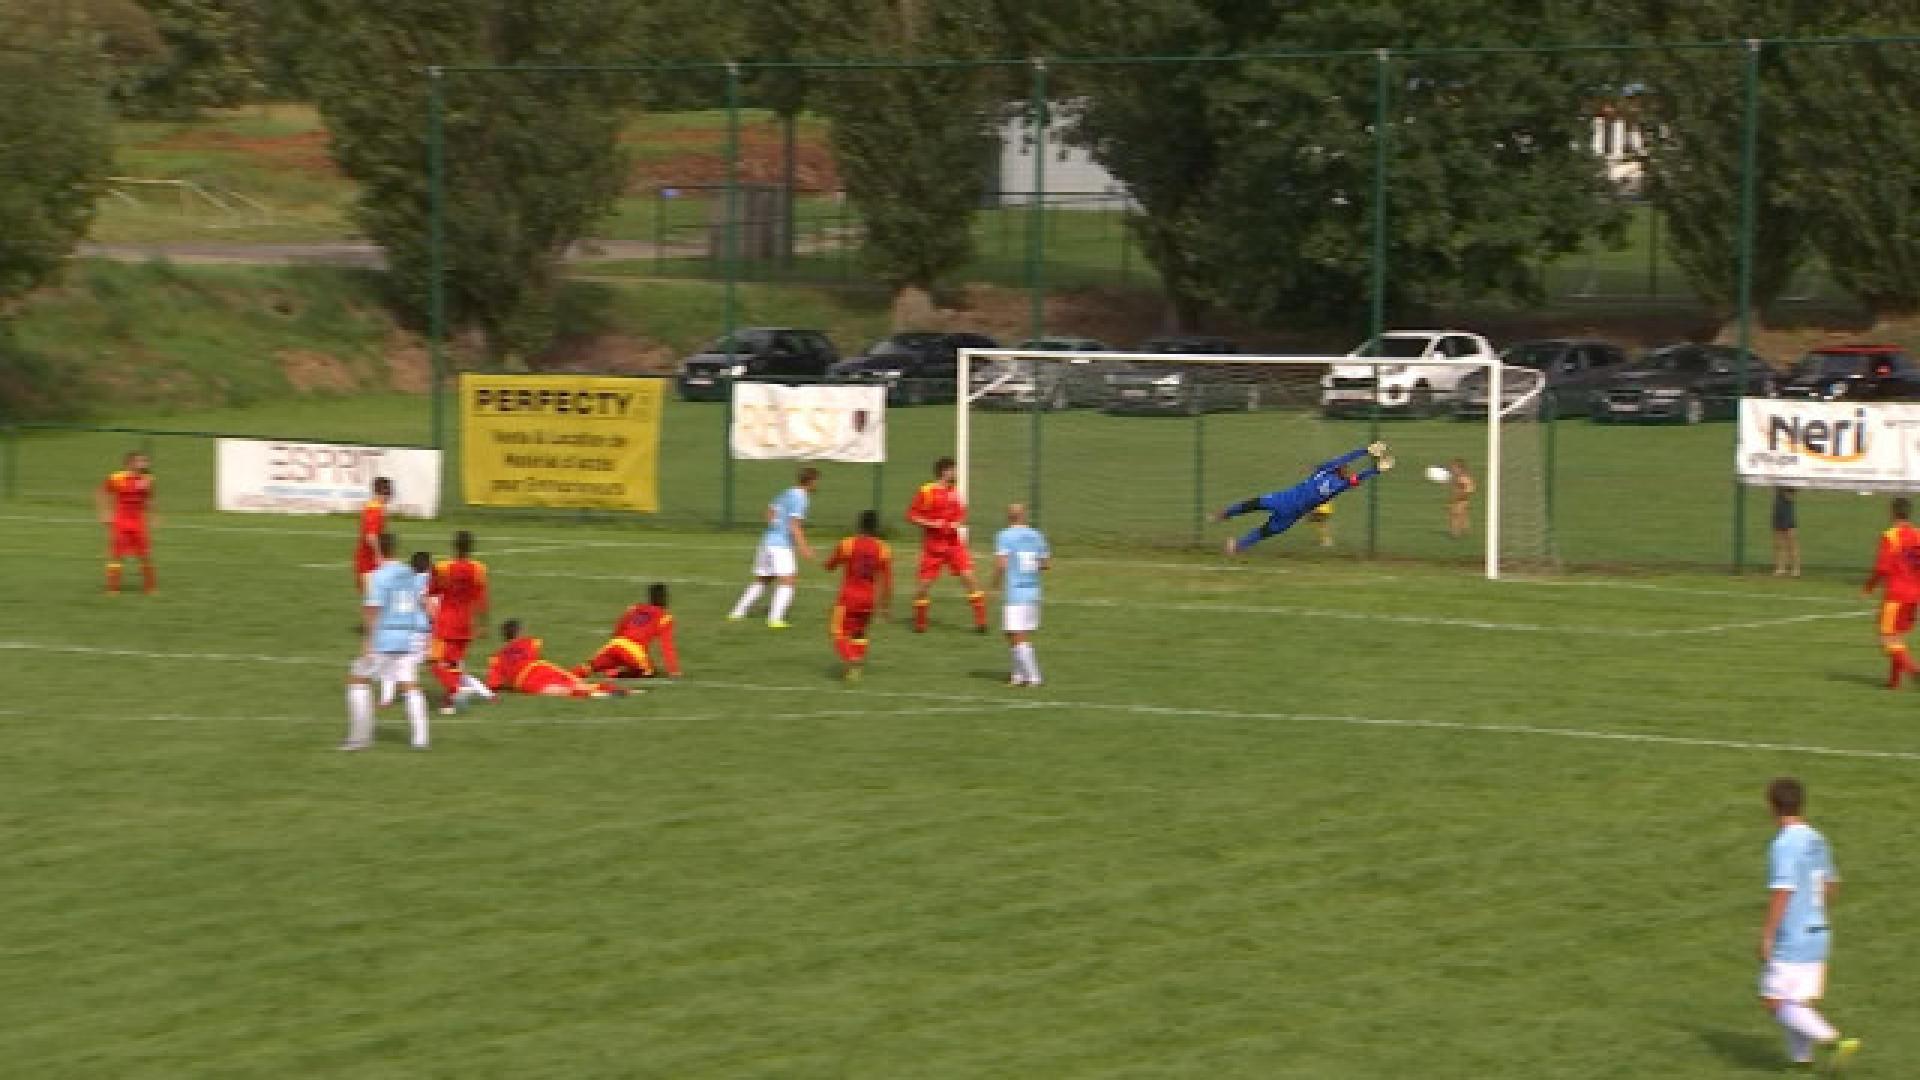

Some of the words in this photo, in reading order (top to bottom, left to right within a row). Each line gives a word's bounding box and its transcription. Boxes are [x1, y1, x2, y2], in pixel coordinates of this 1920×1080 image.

[475, 388, 634, 416] PERFECTY
[1767, 406, 1868, 457] Neri
[265, 445, 387, 485] ESPRIT
